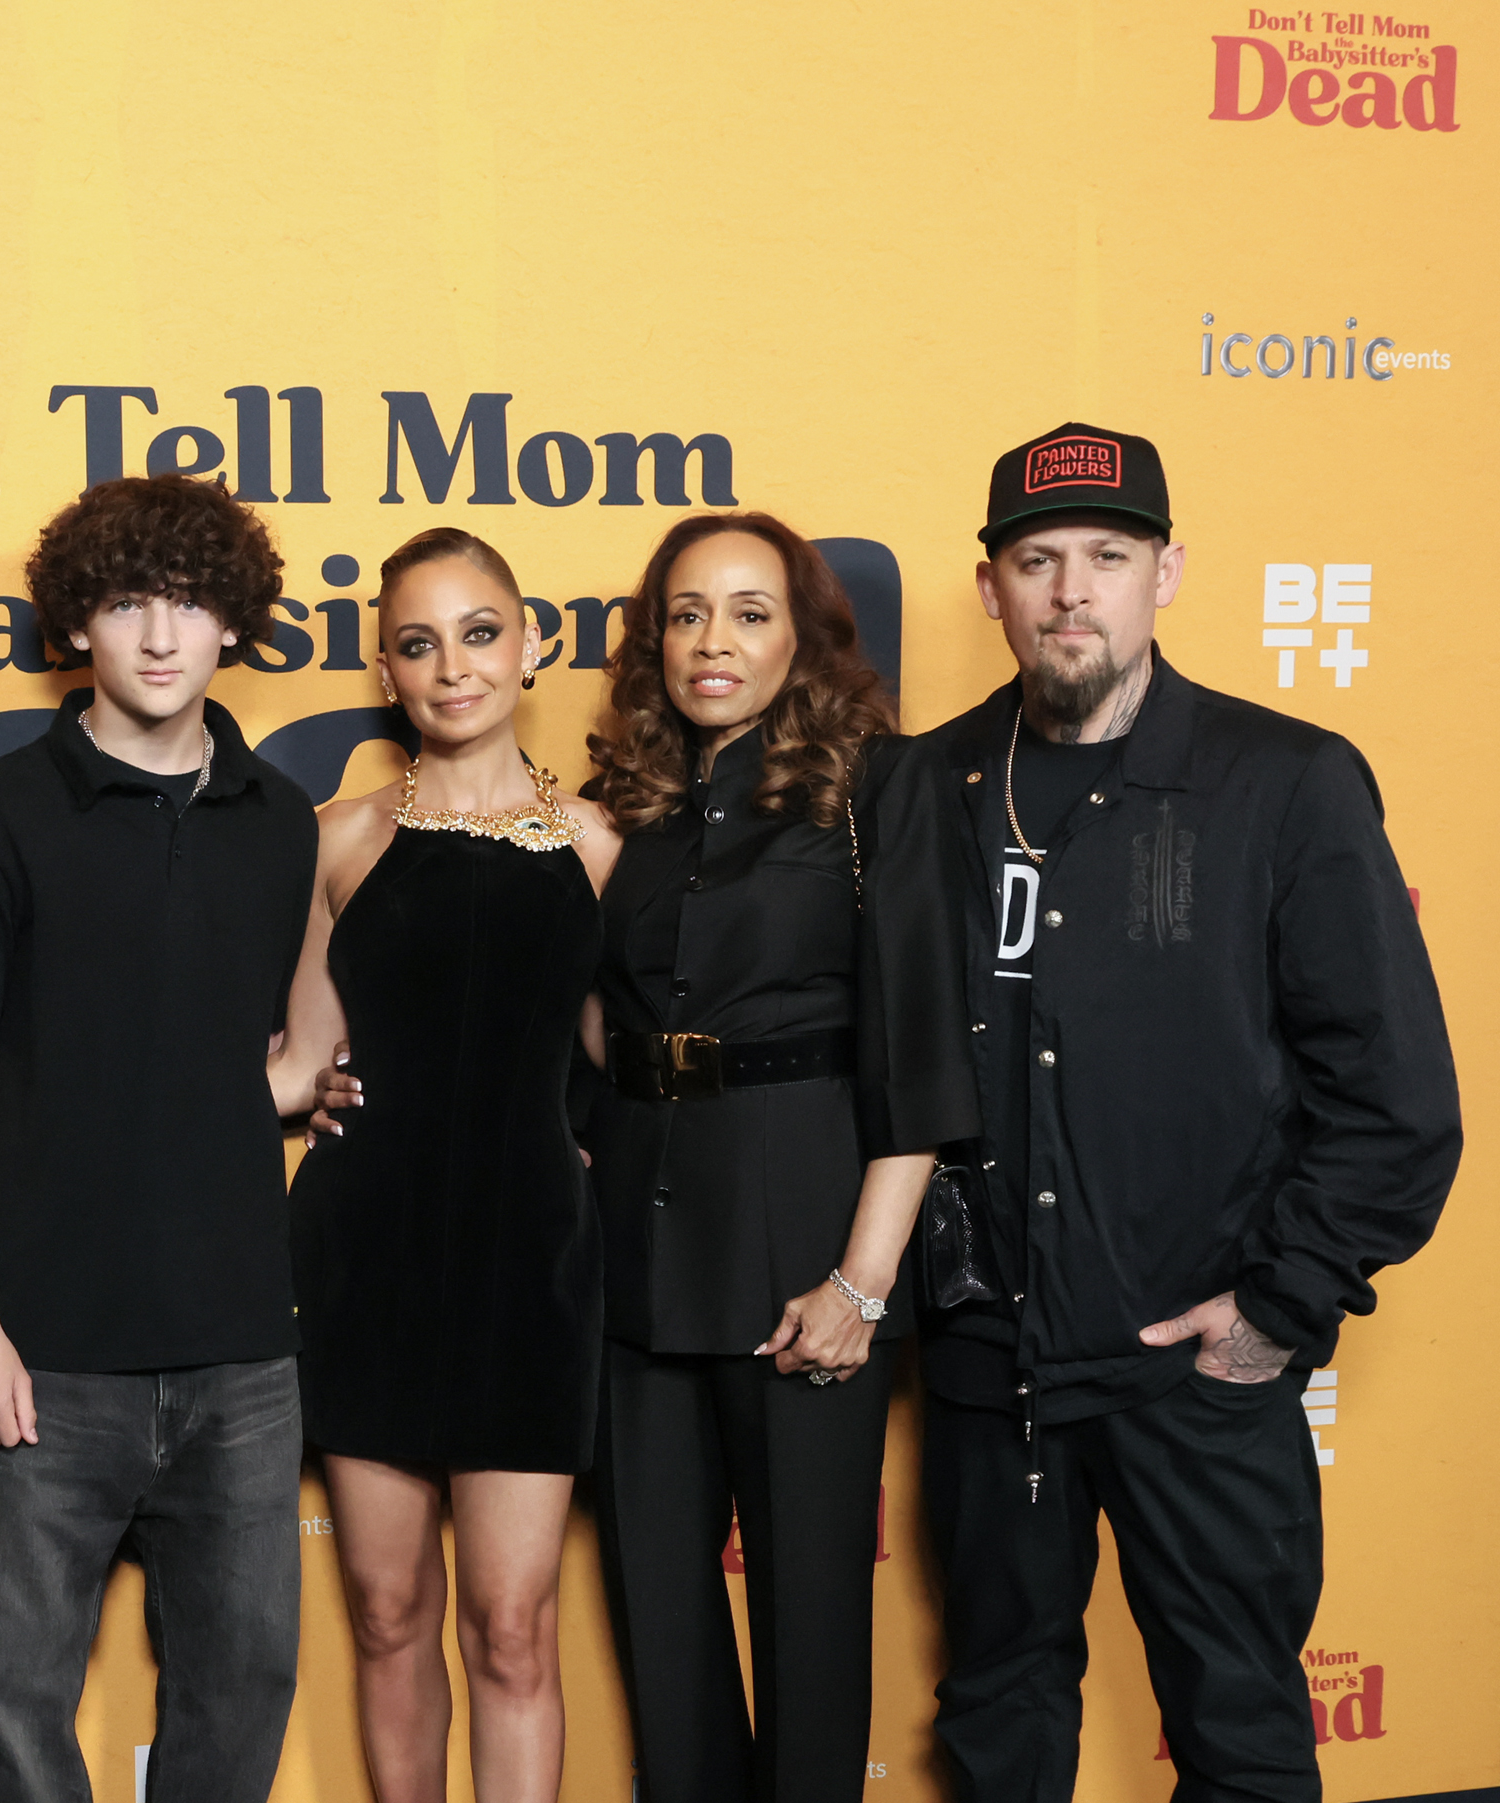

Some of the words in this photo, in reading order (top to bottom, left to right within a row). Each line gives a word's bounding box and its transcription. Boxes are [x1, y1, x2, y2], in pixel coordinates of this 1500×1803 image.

[1248, 8, 1314, 33] Don't
[1321, 12, 1365, 36] Tell
[1372, 15, 1431, 39] Mom
[1287, 40, 1430, 70] Babysitter's
[1334, 37, 1354, 49] the
[1208, 35, 1461, 132] Dead
[1201, 312, 1396, 382] iconic
[1375, 349, 1452, 371] events
[47, 385, 332, 504] Tell
[379, 391, 739, 507] Mom
[1036, 444, 1109, 468] PAINTED
[1032, 461, 1113, 484] FLOWERS
[1304, 1648, 1360, 1669] Mom
